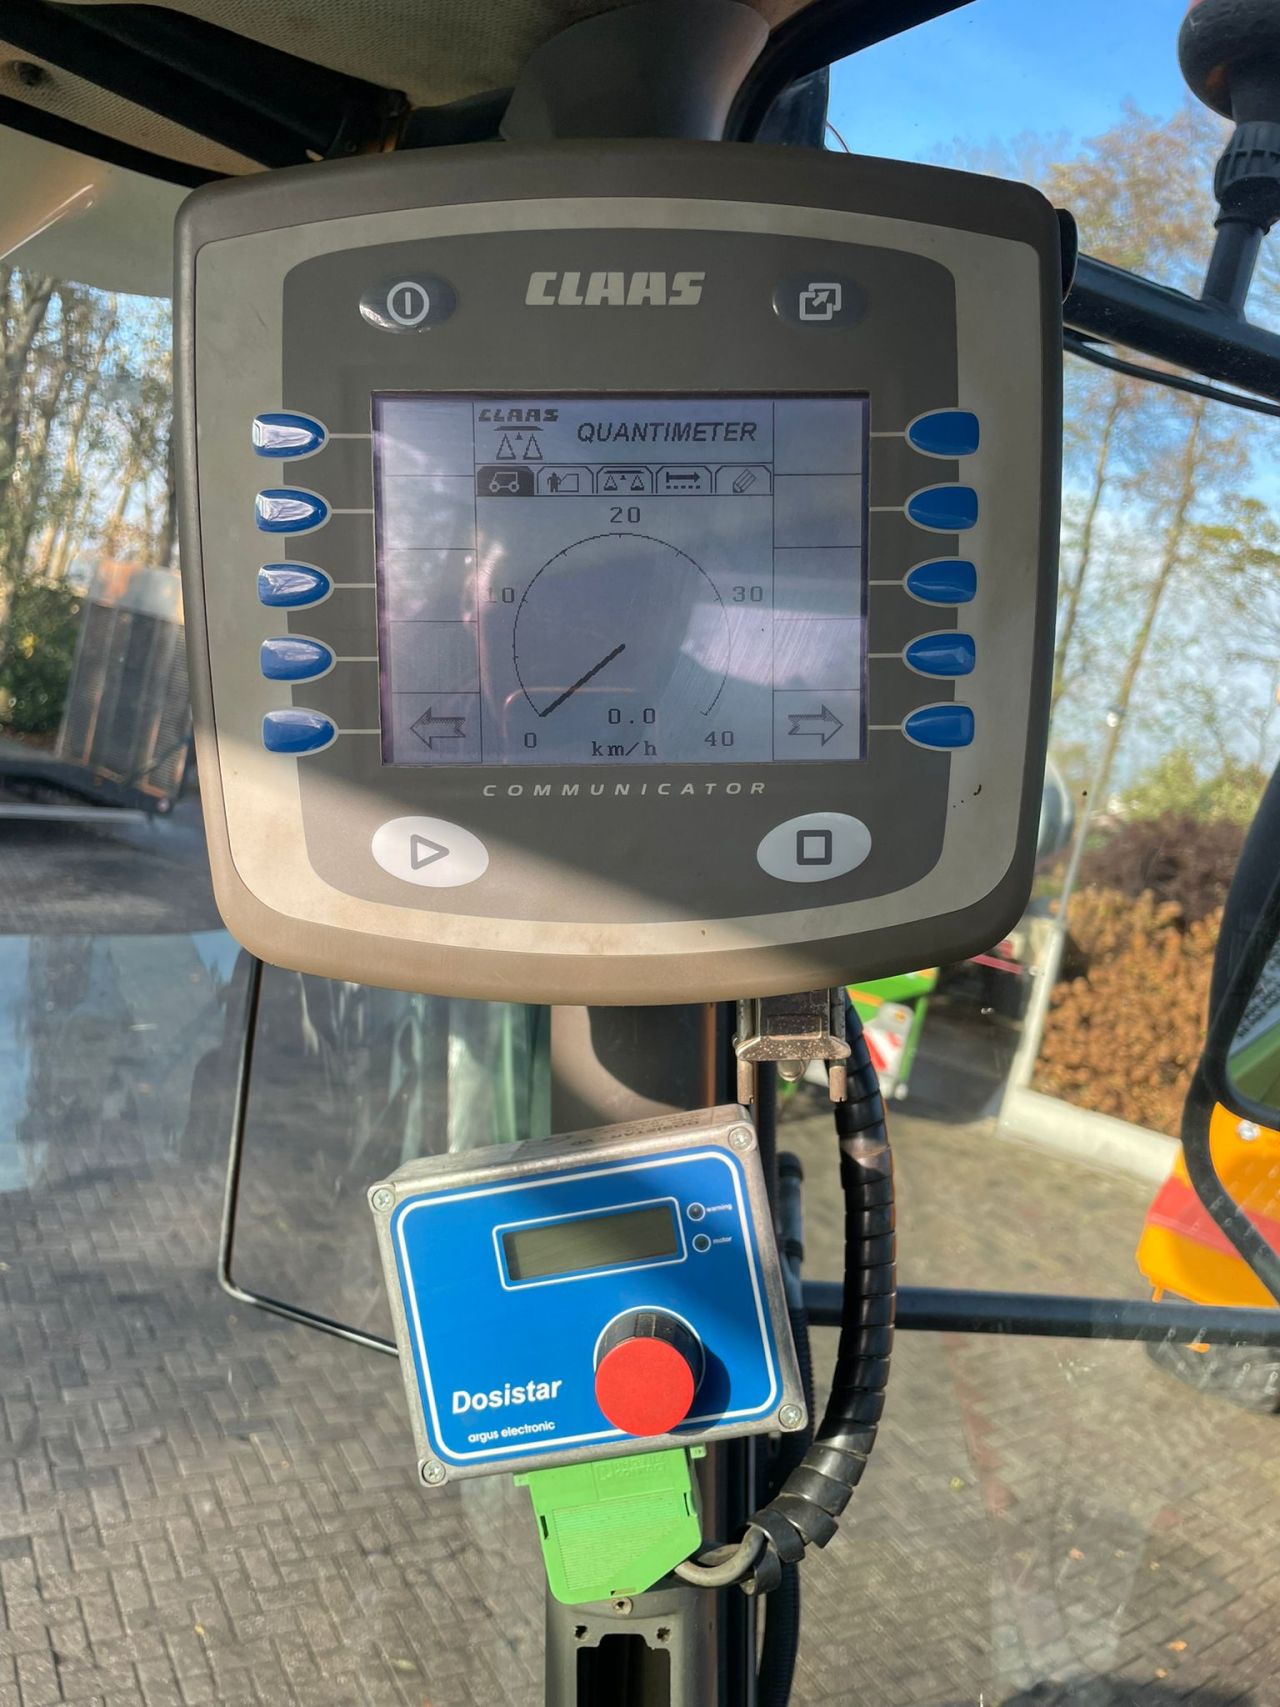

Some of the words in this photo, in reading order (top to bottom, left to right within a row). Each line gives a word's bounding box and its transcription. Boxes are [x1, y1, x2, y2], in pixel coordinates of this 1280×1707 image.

[525, 271, 706, 306] CLAAS
[478, 408, 559, 422] CLAAS
[577, 422, 757, 445] QUANTIMETER
[609, 506, 642, 524] 20
[732, 585, 764, 603] 30
[607, 707, 657, 725] 0.0
[523, 732, 538, 749] 0
[704, 730, 735, 747] 40
[591, 740, 658, 757] km/h
[482, 782, 766, 797] COMMUNICATOR
[452, 1380, 562, 1415] Dosistar
[467, 1429, 499, 1443] argus
[501, 1420, 556, 1438] electronic
